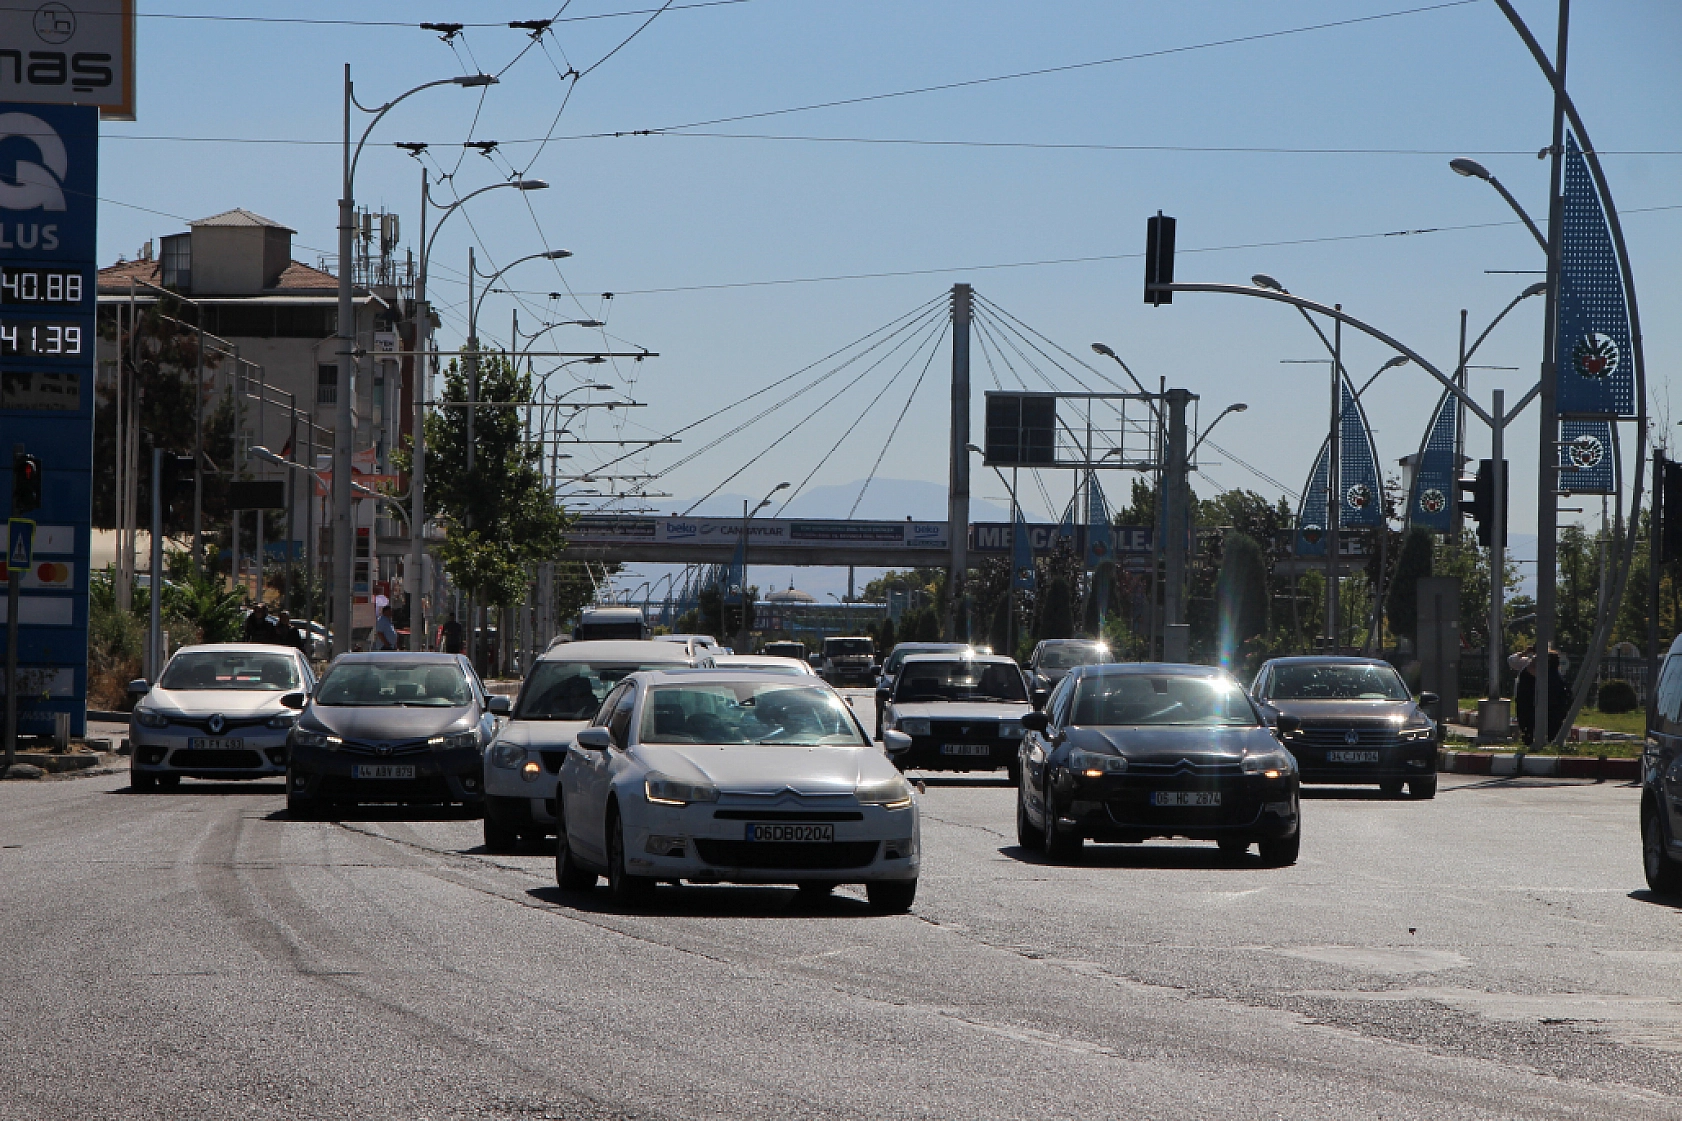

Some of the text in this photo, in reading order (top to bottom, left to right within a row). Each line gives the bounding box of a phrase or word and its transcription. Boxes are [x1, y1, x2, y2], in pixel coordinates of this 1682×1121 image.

[2, 273, 83, 300] 40.88
[1, 326, 81, 354] 41.39
[667, 522, 697, 534] beko
[914, 524, 940, 534] beko
[1176, 791, 1189, 805] HC
[753, 826, 832, 841] 06DB0204
